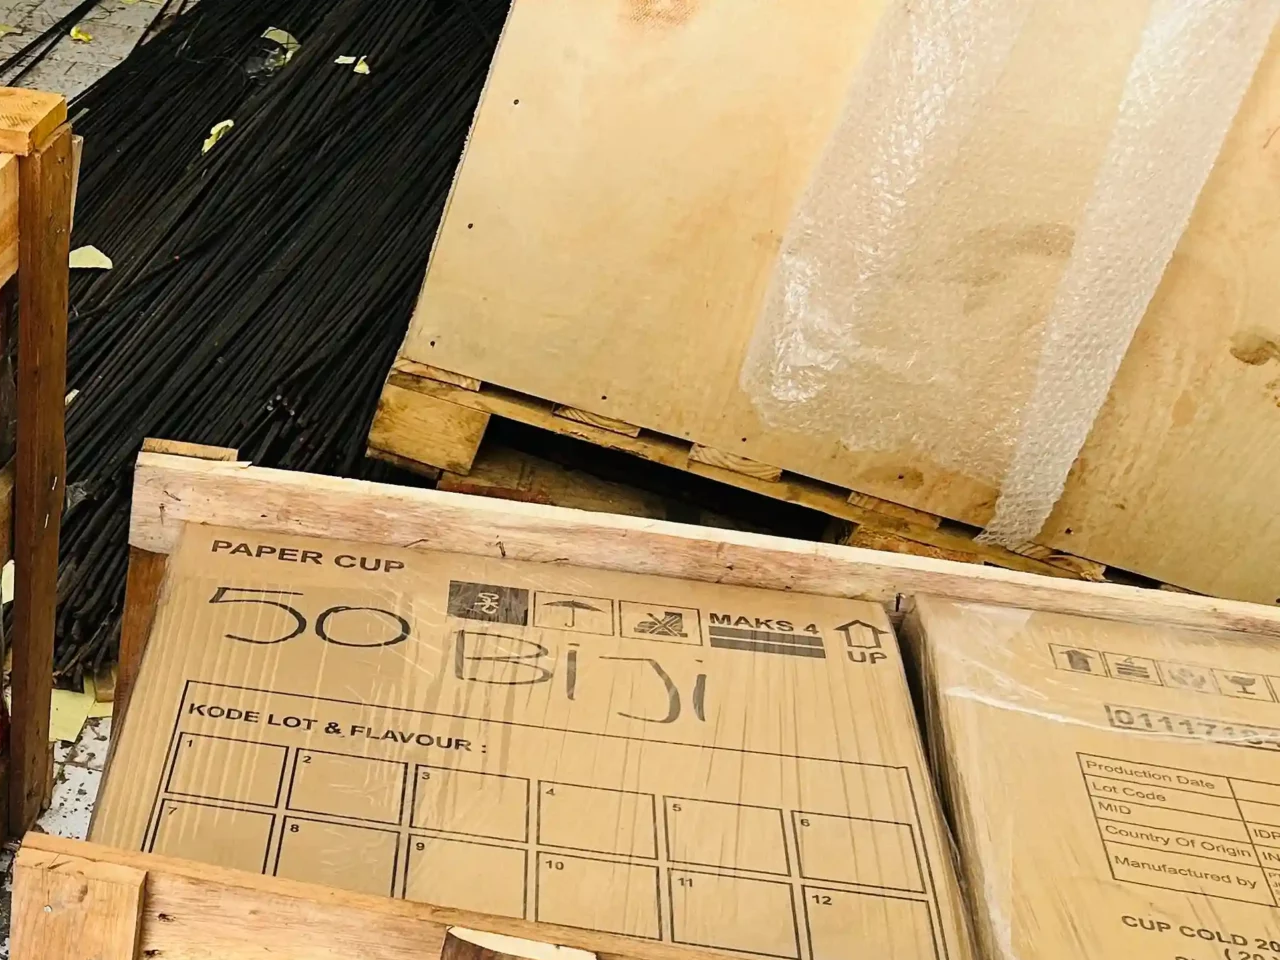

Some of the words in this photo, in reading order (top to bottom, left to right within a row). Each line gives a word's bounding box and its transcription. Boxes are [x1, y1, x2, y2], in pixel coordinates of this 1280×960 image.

[211, 539, 323, 565] PAPER
[334, 554, 405, 573] CUP
[208, 586, 411, 648] 50
[709, 613, 794, 632] MAKS
[803, 623, 820, 635] 4
[847, 651, 888, 665] UP
[188, 703, 261, 723] KODE
[267, 713, 319, 731] LOT
[324, 722, 342, 735] &
[350, 725, 473, 752] FLAVOUR
[186, 739, 194, 748] 1
[302, 755, 312, 764] 2
[422, 771, 431, 780] 3
[1086, 760, 1172, 782] Production
[1176, 775, 1216, 790] Date
[546, 788, 556, 797] 4
[1091, 782, 1120, 795] Lot
[1122, 784, 1167, 802] Code
[168, 806, 178, 816] 7
[672, 803, 682, 813] 5
[1098, 801, 1132, 815] MID
[289, 823, 300, 833] 8
[800, 818, 811, 828] 6
[416, 841, 425, 851] 9
[1105, 825, 1171, 846] Country
[1175, 837, 1196, 849] Of
[1201, 841, 1252, 859] Origin
[545, 860, 565, 871] 10
[1114, 855, 1232, 884] Manufactured
[1236, 876, 1258, 890] by
[677, 877, 694, 888] 11
[812, 894, 833, 906] 12
[1121, 915, 1171, 933] CUP
[1179, 925, 1248, 946] COLD
